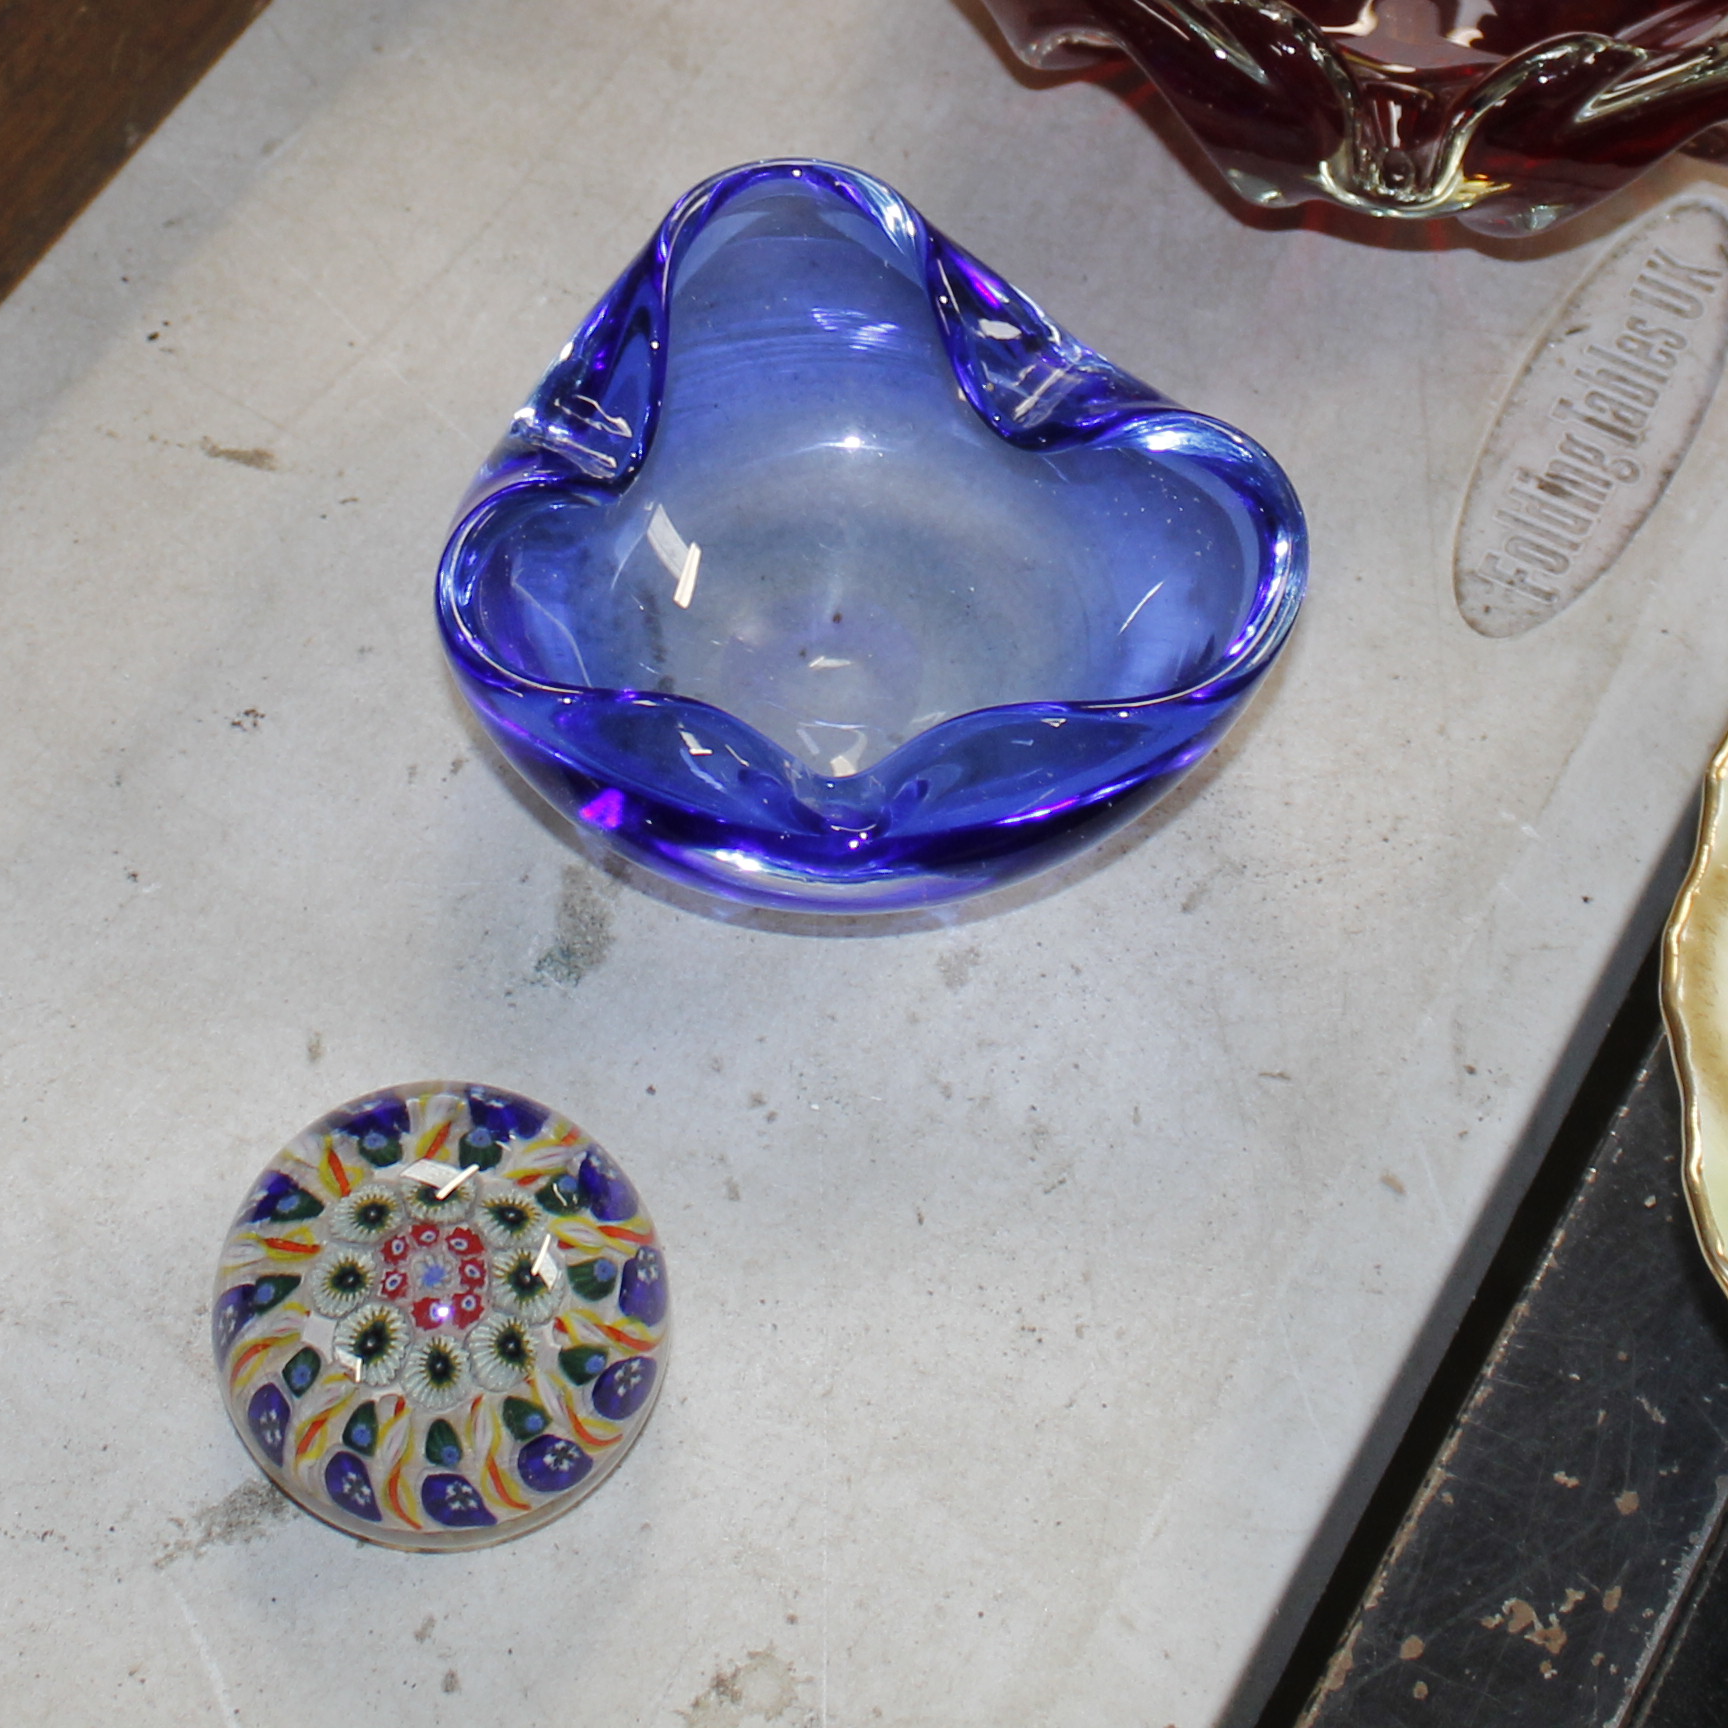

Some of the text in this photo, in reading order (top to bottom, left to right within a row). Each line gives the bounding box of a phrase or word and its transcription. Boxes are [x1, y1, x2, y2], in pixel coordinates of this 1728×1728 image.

[1476, 245, 1725, 604] Folding Tables UK
